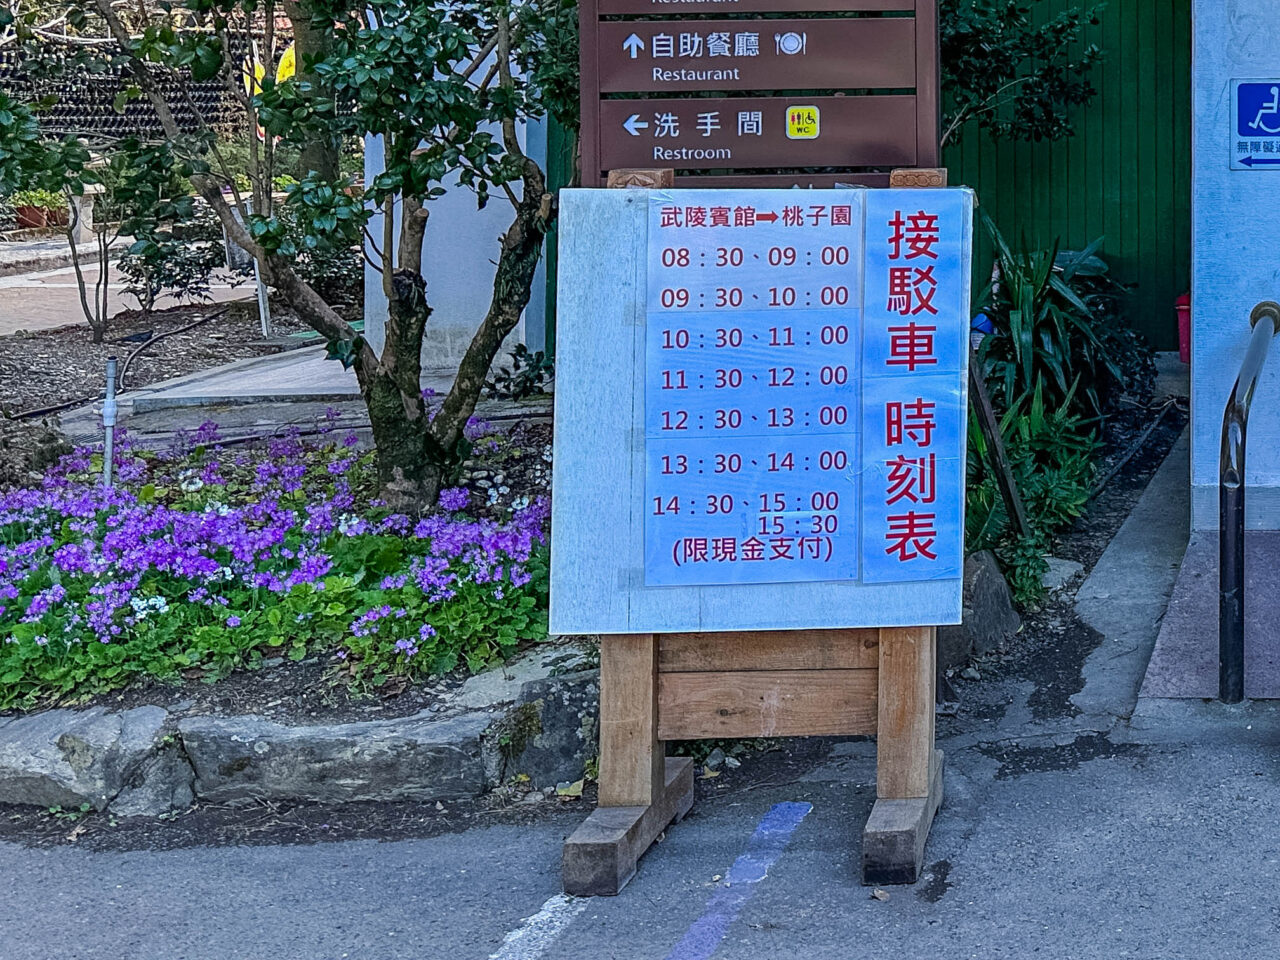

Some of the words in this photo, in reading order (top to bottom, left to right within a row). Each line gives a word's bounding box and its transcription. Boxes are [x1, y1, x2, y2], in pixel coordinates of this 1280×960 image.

[651, 32, 760, 58] 自助餐廳
[652, 68, 740, 81] Restaurant
[796, 126, 810, 134] WC
[653, 147, 731, 160] Restroom
[660, 205, 757, 228] 武陵賓館
[782, 204, 853, 227] 桃子園
[885, 210, 940, 373] 接駁車
[884, 397, 938, 563] 時刻表
[673, 535, 833, 566] (限現金支付)
